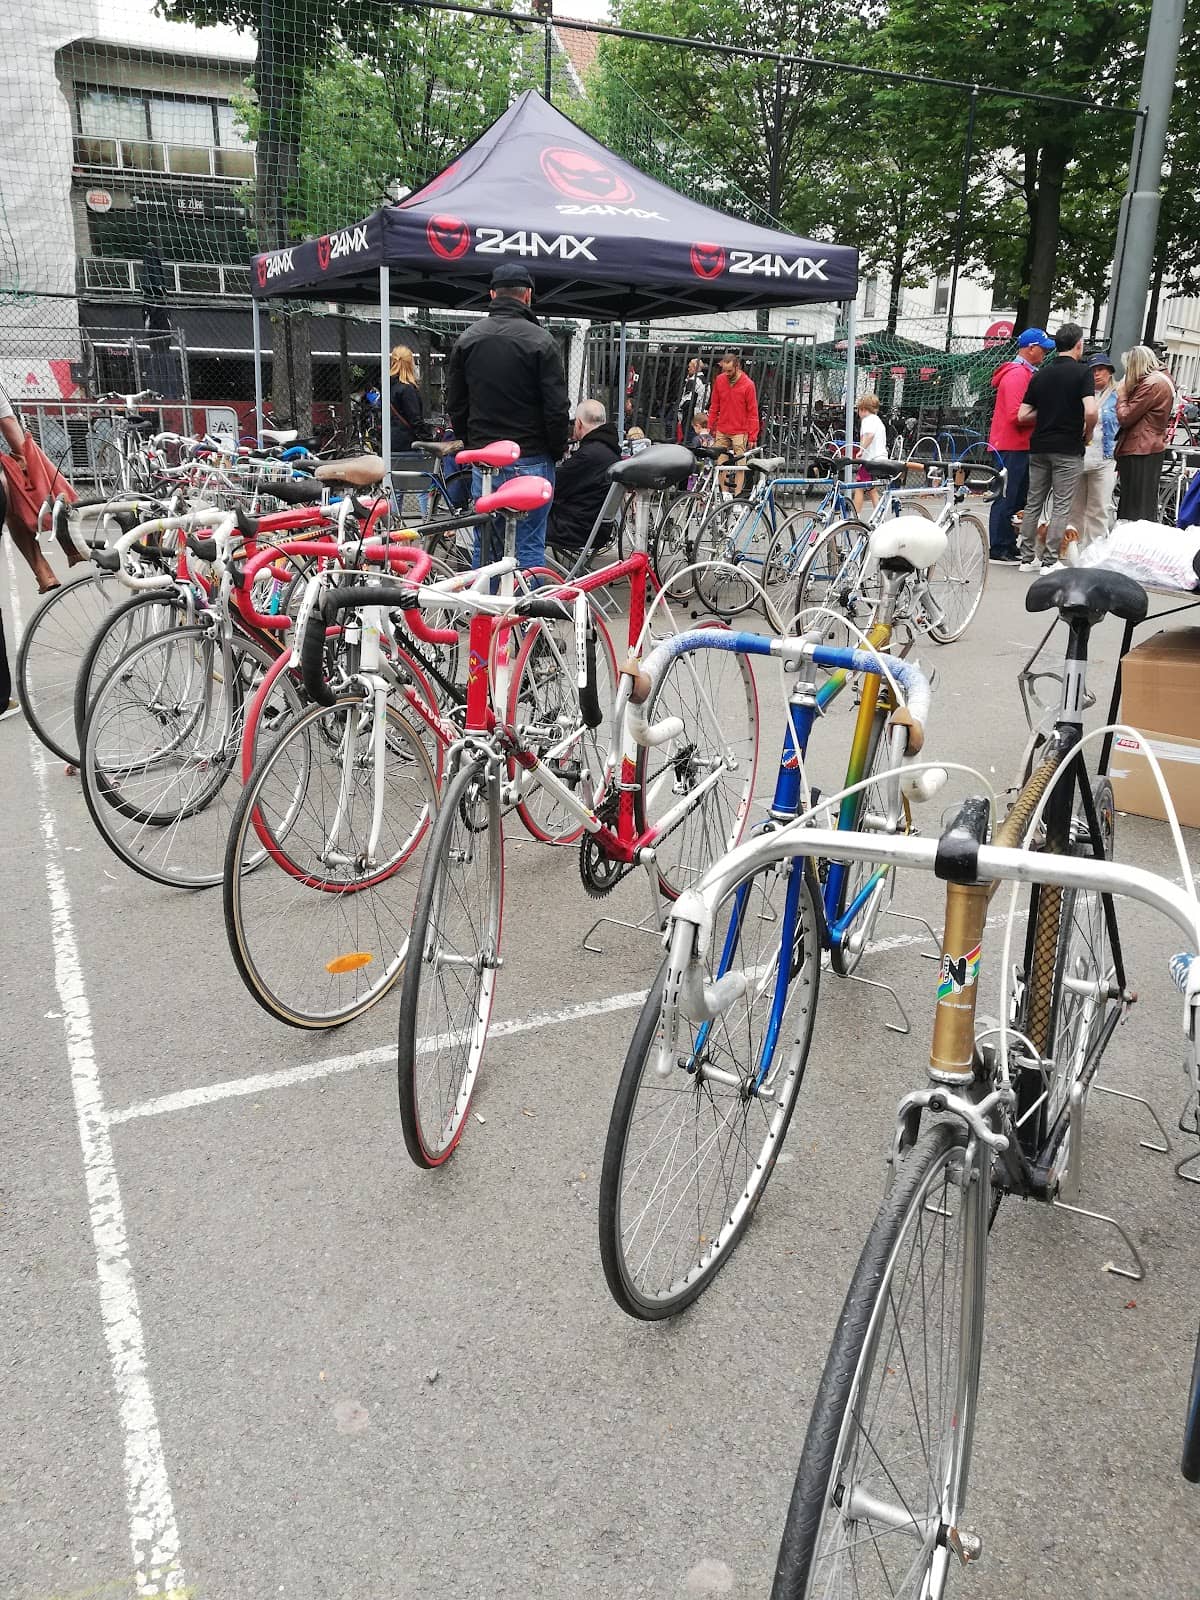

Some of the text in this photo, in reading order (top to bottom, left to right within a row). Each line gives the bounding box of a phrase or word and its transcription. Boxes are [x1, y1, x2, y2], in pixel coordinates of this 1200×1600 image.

[555, 204, 671, 223] 24MX
[328, 224, 369, 260] 24MX
[474, 227, 598, 261] 24MX
[265, 249, 295, 279] 24MX
[728, 251, 830, 281] 24MX
